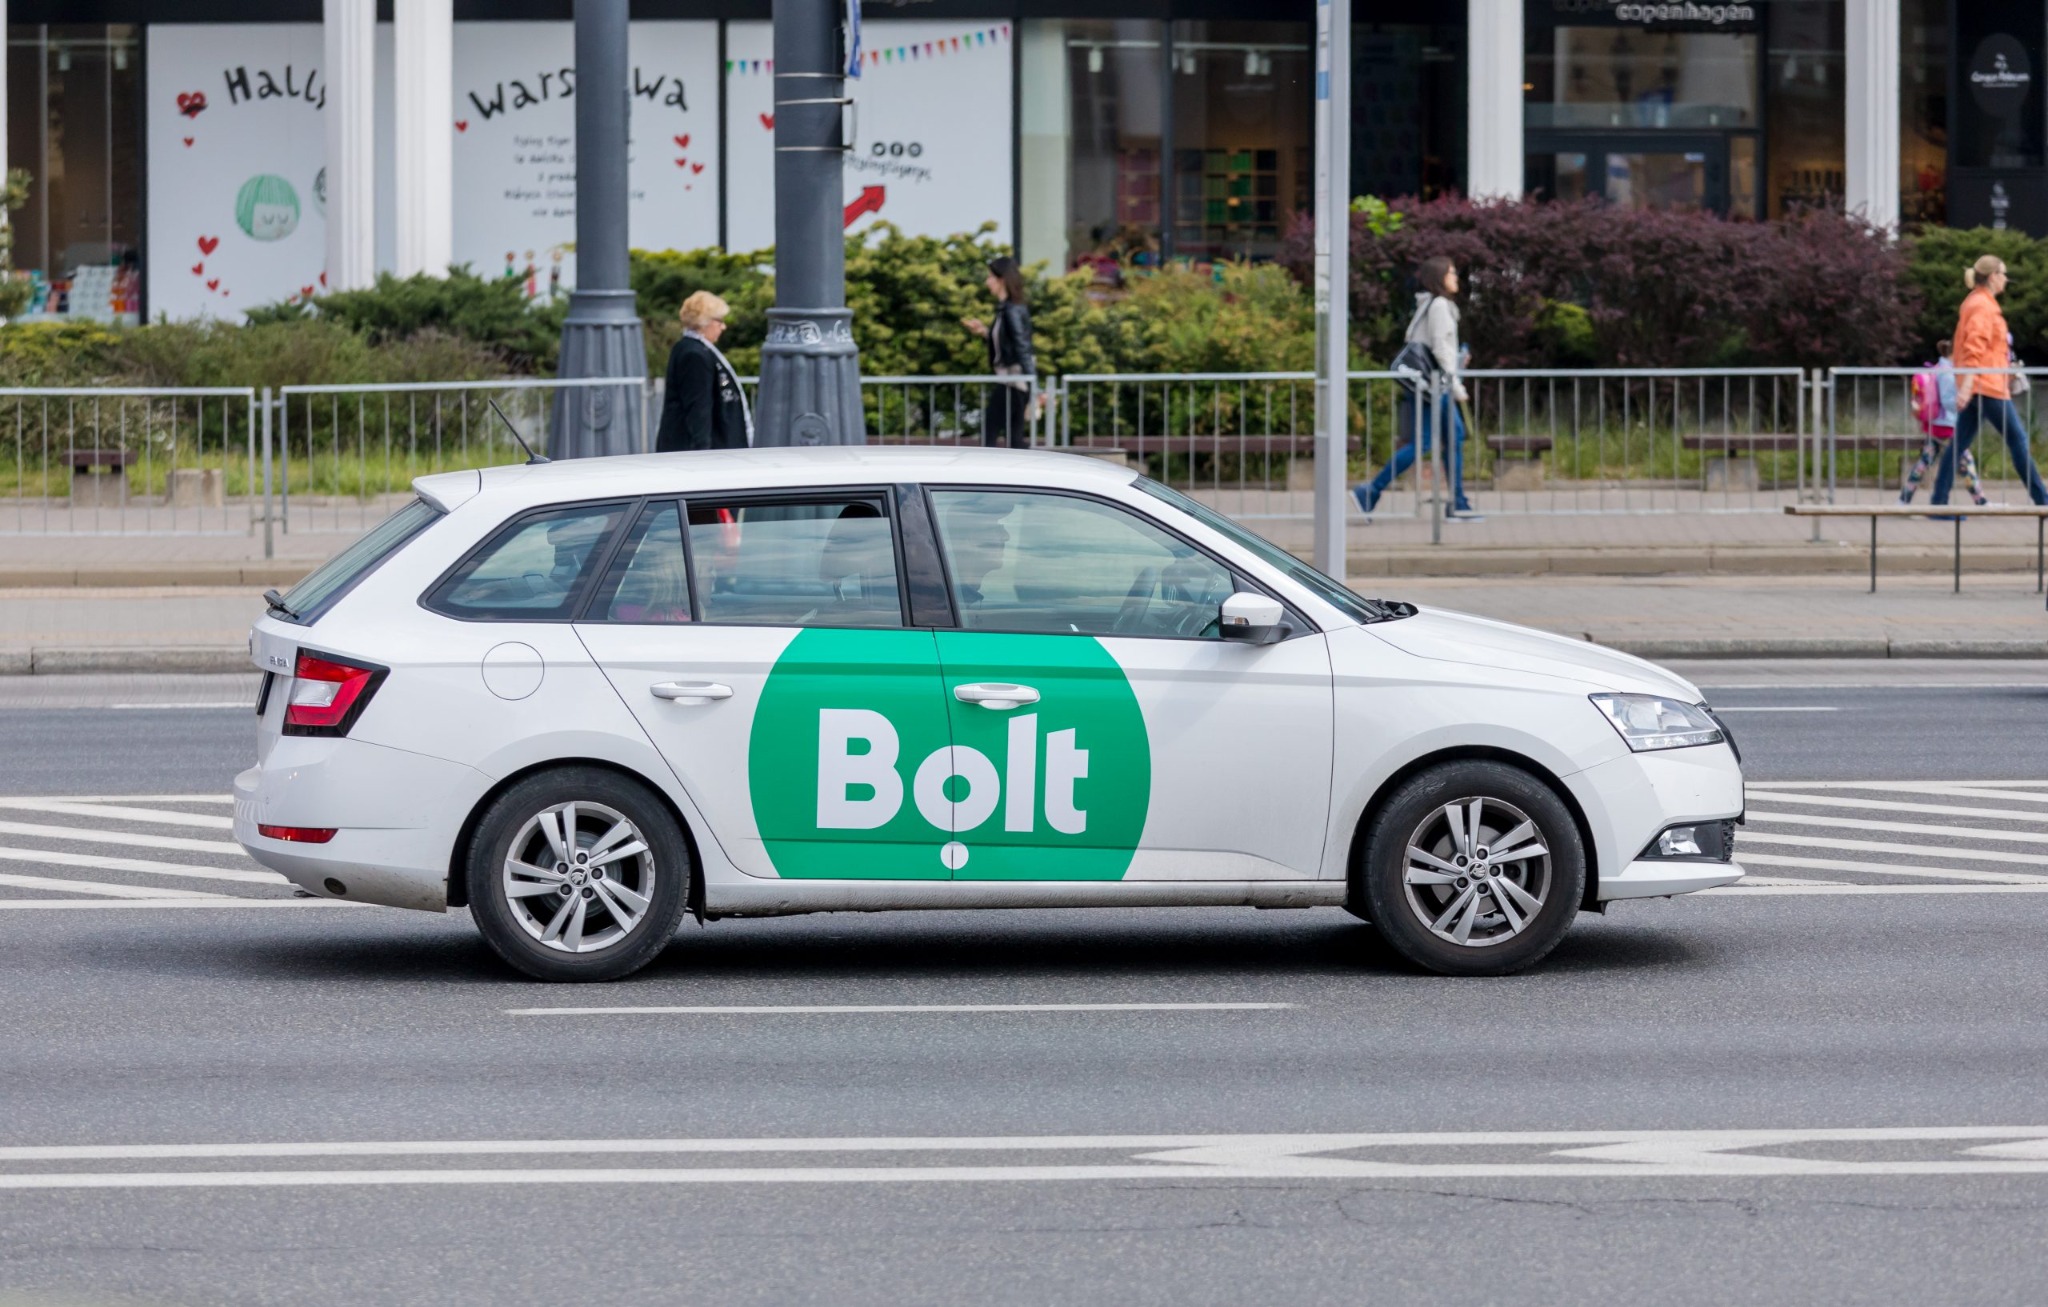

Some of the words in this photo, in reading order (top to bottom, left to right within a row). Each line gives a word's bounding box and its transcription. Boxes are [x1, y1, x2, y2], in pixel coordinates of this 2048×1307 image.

[1615, 1, 1755, 24] copenhagen
[469, 67, 688, 120] Warswa
[816, 708, 1089, 834] Bolt
